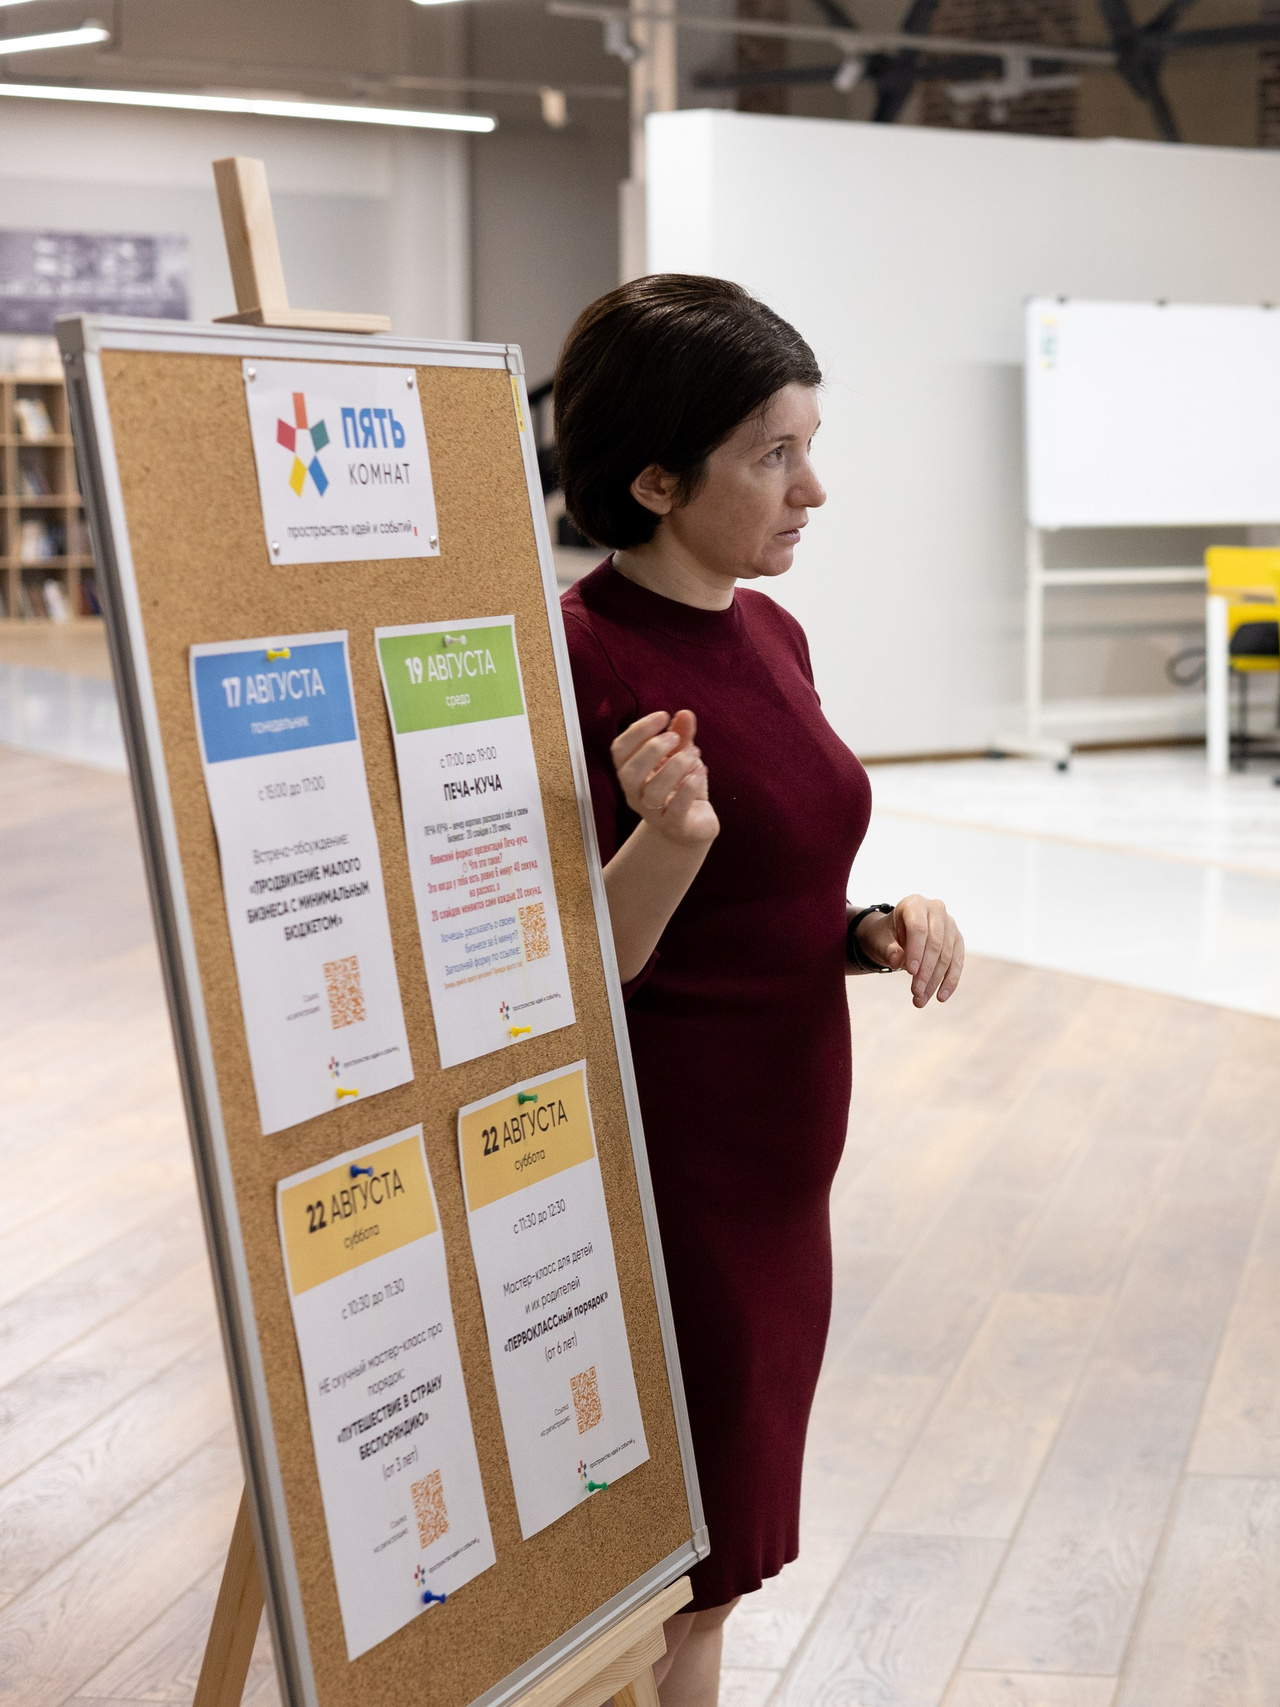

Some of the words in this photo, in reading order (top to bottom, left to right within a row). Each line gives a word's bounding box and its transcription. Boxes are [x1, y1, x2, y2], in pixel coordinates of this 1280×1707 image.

[341, 407, 405, 448] ПЯТЬ
[348, 463, 410, 485] КОМНАТ
[287, 524, 349, 540] пространство
[351, 522, 370, 536] идей
[380, 520, 412, 534] событий
[405, 656, 422, 685] 19
[428, 649, 497, 682] АВГУСТА
[222, 677, 240, 708] 17
[245, 668, 326, 705] АВГУСТА
[446, 693, 470, 708] среда
[440, 758, 445, 768] с
[446, 752, 464, 767] 17:00
[466, 753, 476, 766] до
[477, 746, 497, 761] 19:00
[258, 790, 265, 801] с
[289, 784, 301, 796] до
[443, 774, 503, 801] ПЕЧА-КУЧА
[250, 866, 321, 894] «ПРОДВИЖЕНИЕ
[322, 857, 361, 879] МАЛОГО
[246, 900, 290, 924] БИЗНЕСА
[291, 899, 298, 912] С
[299, 881, 371, 909] МИНИМАЛЬНЫМ
[284, 914, 343, 941] БЮДЖЕТОМ»
[482, 1126, 499, 1156] 22
[503, 1099, 568, 1148] АВГУСТА
[514, 1149, 546, 1172] суббота
[306, 1200, 327, 1234] 22
[331, 1169, 405, 1223] АВГУСТА
[513, 1223, 519, 1234] с
[519, 1213, 537, 1231] 11:30
[538, 1211, 548, 1226] до
[548, 1199, 566, 1216] 12:30
[344, 1224, 380, 1249] суббота
[503, 1262, 557, 1297] Мастер-класс
[558, 1255, 571, 1271] для
[572, 1242, 593, 1264] детей
[341, 1307, 348, 1320] с
[349, 1293, 371, 1315] 10:30
[372, 1291, 384, 1308] до
[384, 1278, 405, 1299] 11:30
[525, 1304, 531, 1314] и
[532, 1299, 540, 1310] их
[541, 1276, 581, 1309] родителей
[504, 1307, 573, 1352] «ПЕРВОКЛАССный
[574, 1291, 608, 1316] порядок»
[319, 1377, 331, 1396] НЕ
[333, 1359, 366, 1388] скучный
[368, 1330, 427, 1368] мастер-класс
[428, 1322, 443, 1340] про
[544, 1346, 556, 1362] (от
[557, 1342, 562, 1354] 6
[563, 1331, 578, 1352] лет)
[337, 1397, 402, 1443] «ПУТЕШЕСТВИЕ
[403, 1393, 409, 1408] В
[410, 1374, 442, 1403] СТРАНУ
[359, 1412, 429, 1460] БЕСПОРЯНДИЮ»
[382, 1463, 394, 1482] (от
[395, 1456, 402, 1472] 3
[402, 1445, 419, 1468] лет)
